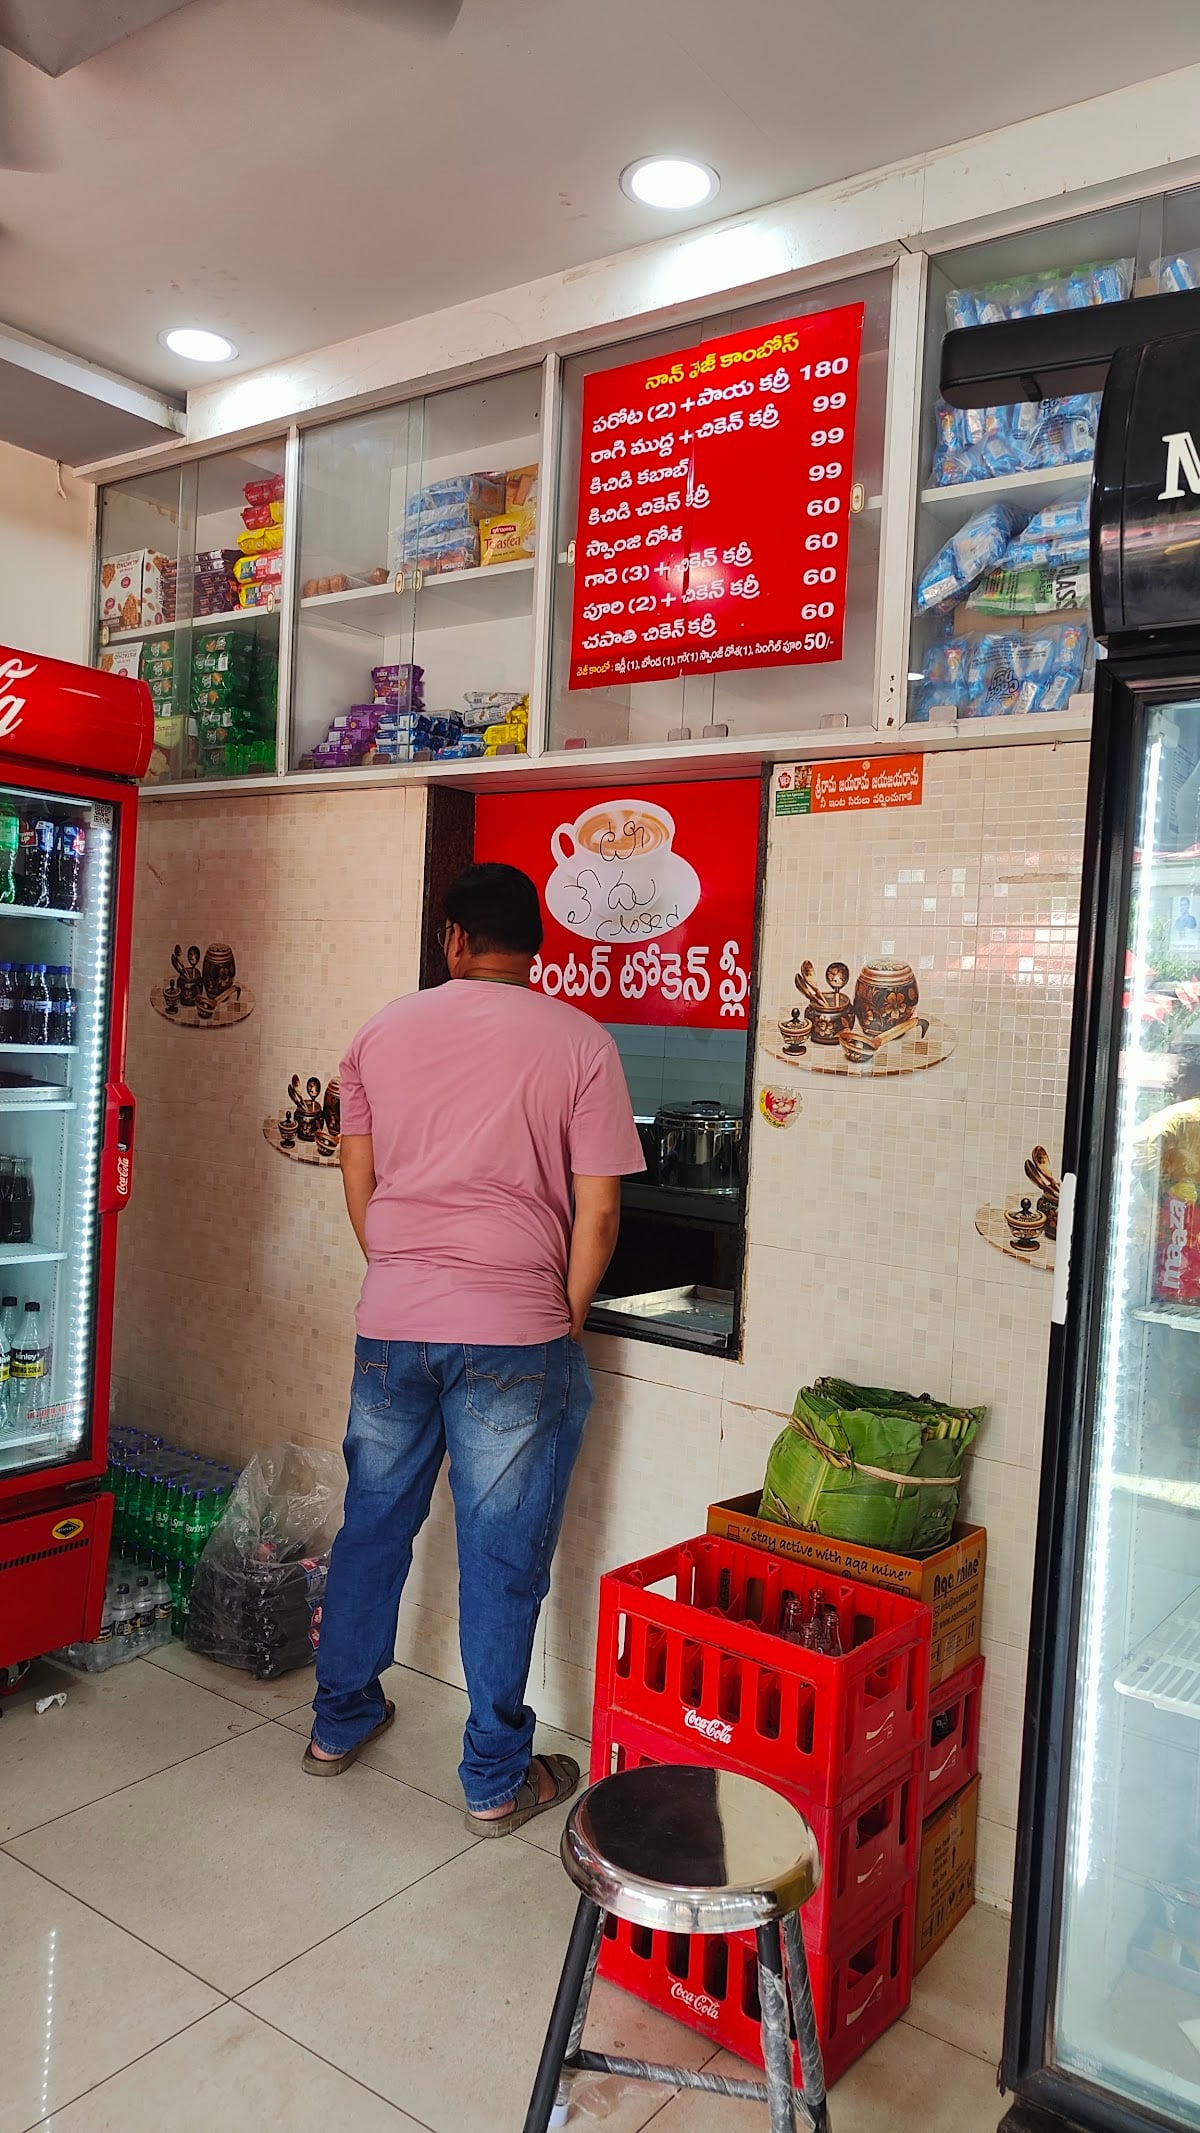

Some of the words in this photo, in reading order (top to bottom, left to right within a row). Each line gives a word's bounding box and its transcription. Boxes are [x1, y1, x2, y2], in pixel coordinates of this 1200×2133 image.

[645, 364, 684, 390] నాన్
[720, 332, 799, 367] కాంబోస్
[592, 408, 643, 433] పరోట
[647, 401, 676, 422] (2)
[759, 368, 790, 393] కర్రీ
[800, 357, 848, 381] 180
[590, 440, 626, 463] రాగి
[630, 433, 674, 457] ముద్ద
[749, 403, 780, 429] కర్రీ
[812, 392, 846, 413] 99
[589, 471, 632, 494] కిచిడి
[637, 458, 689, 485] కబాబ్
[810, 427, 844, 448] 99
[588, 502, 631, 525] కిచిడి
[635, 491, 680, 516] చికెన్
[808, 462, 842, 483] 99
[586, 533, 642, 559] స్పాంజి
[646, 525, 683, 546] దోశ
[807, 497, 840, 516] 60
[585, 568, 617, 588] గారె
[622, 565, 650, 584] (3)
[722, 542, 753, 568] కర్రీ
[805, 532, 838, 551] 60
[583, 601, 624, 621] పూరి
[628, 595, 656, 614] (2)
[681, 579, 724, 604] చికెన్
[729, 573, 760, 599] కర్రీ
[803, 567, 837, 586] 60
[582, 629, 637, 649] చపాతి
[641, 618, 685, 641] చికెన్
[688, 613, 717, 638] కర్రీ
[801, 602, 834, 620] 60
[619, 942, 710, 1002] టోకెన్
[779, 1539, 813, 1557] active
[815, 1549, 841, 1565] with
[845, 1556, 867, 1574] aqa
